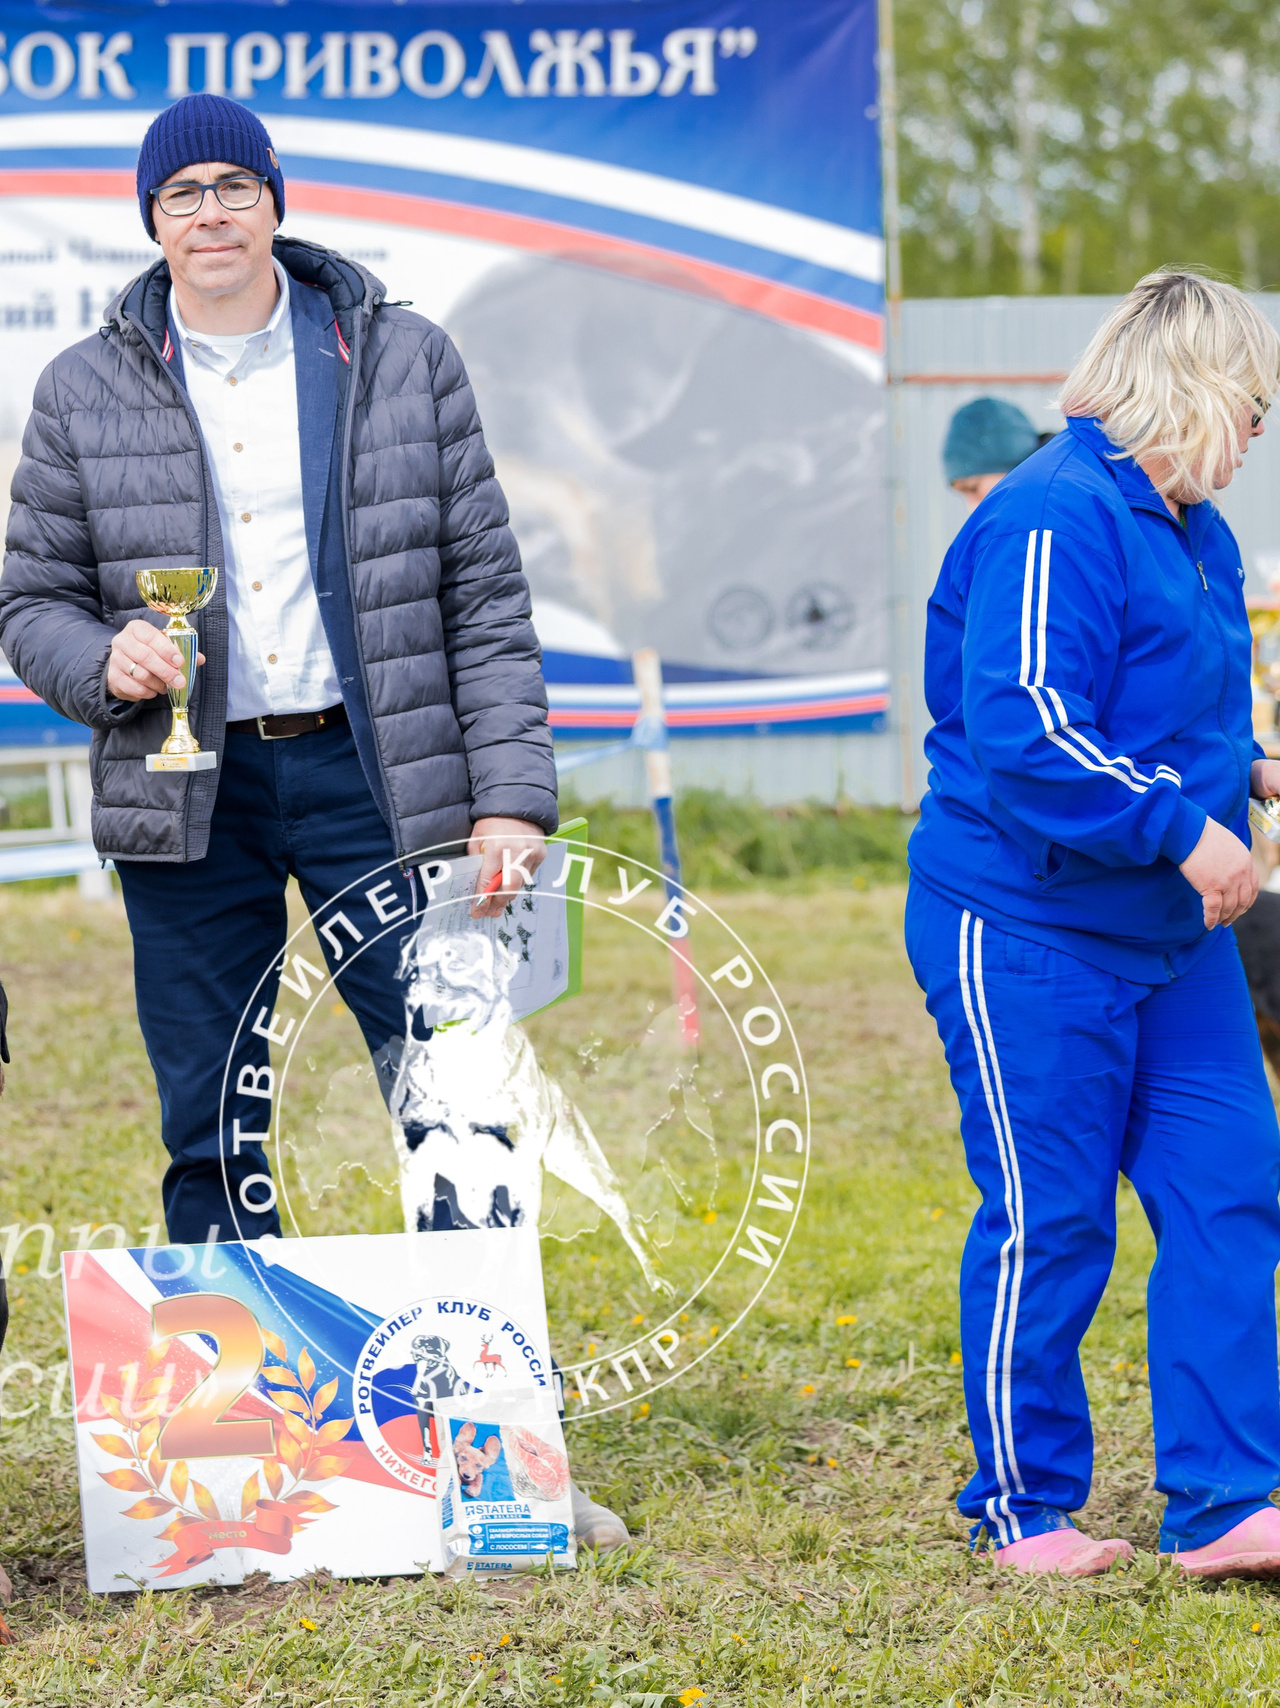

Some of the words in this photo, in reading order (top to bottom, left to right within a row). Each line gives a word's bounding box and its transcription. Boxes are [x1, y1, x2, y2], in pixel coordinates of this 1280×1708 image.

[150, 1291, 278, 1461] 2
[357, 1305, 424, 1415] РОТВЕЙЛЕР
[437, 1300, 492, 1322] КЛУБ
[475, 1503, 531, 1514] STATERA
[475, 1561, 513, 1569] STATERA
